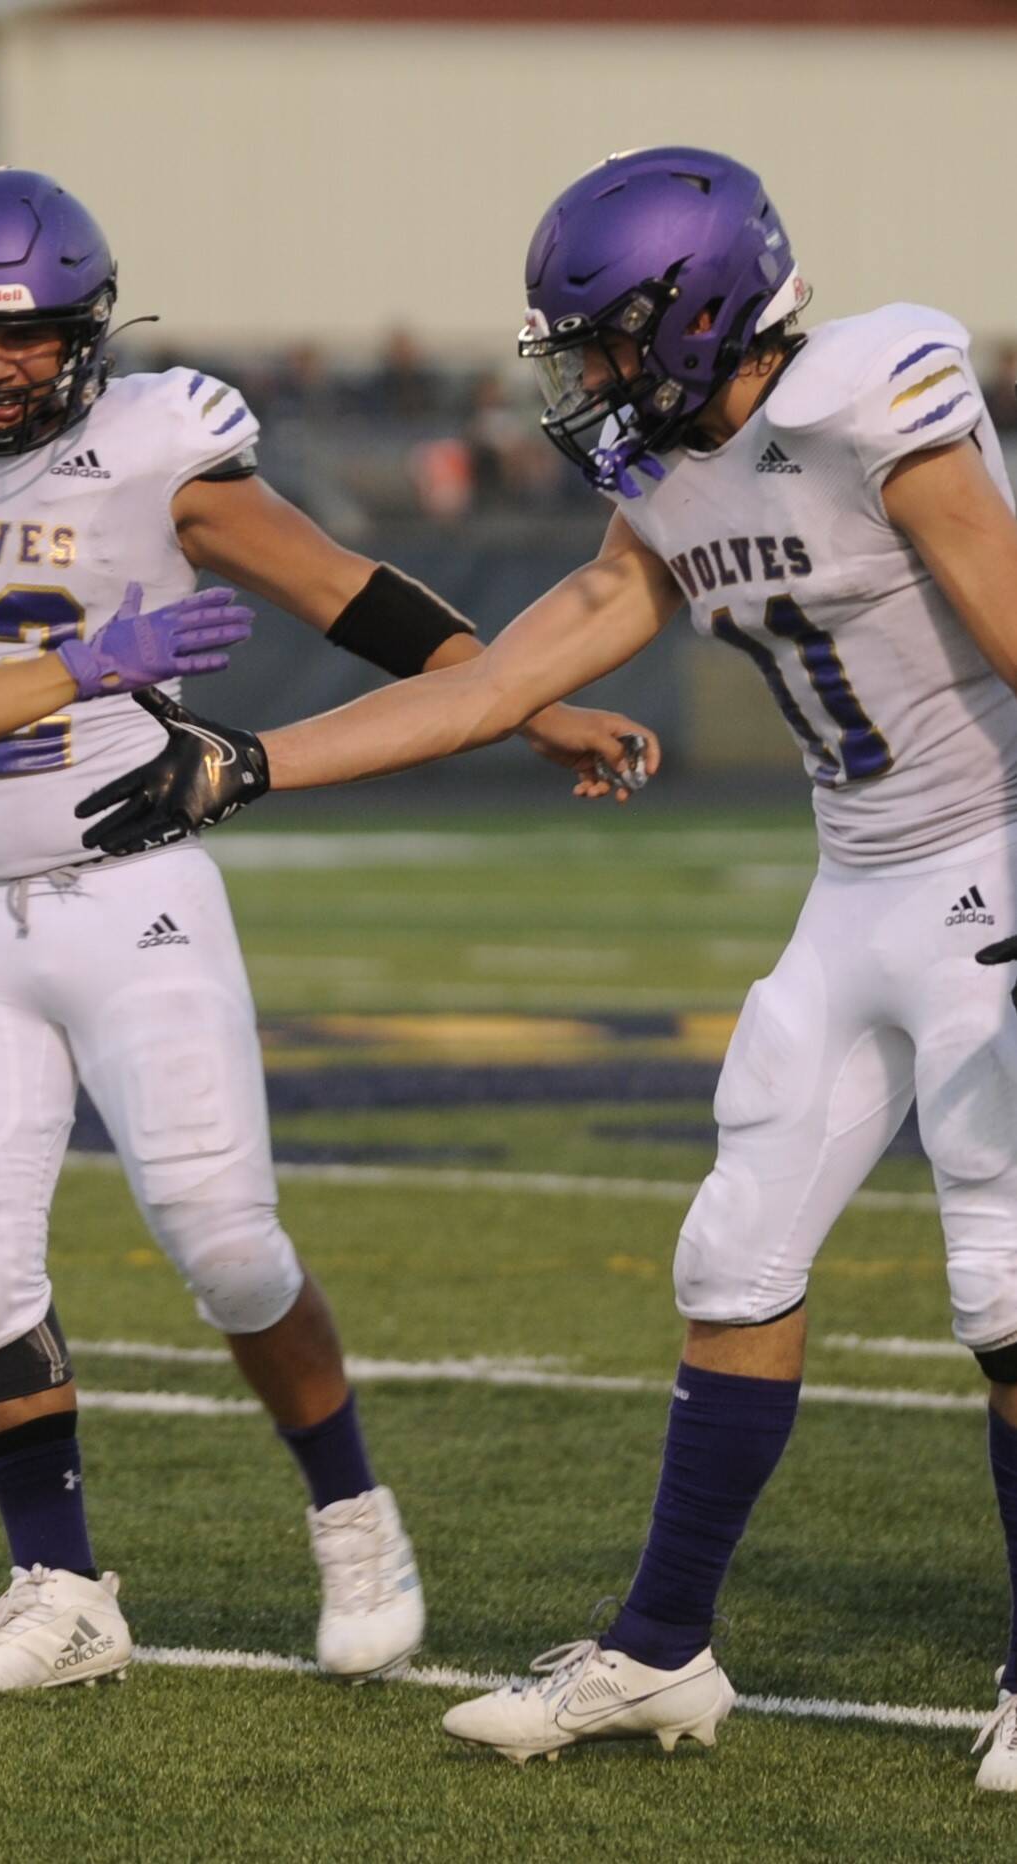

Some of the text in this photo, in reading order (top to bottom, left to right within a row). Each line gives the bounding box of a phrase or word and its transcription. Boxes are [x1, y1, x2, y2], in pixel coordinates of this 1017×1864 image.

[49, 465, 112, 480] adidas
[755, 460, 803, 475] adidas
[711, 593, 895, 789] 11
[945, 908, 996, 927] adidas
[136, 932, 191, 950] adidas
[54, 1635, 115, 1671] adidas
